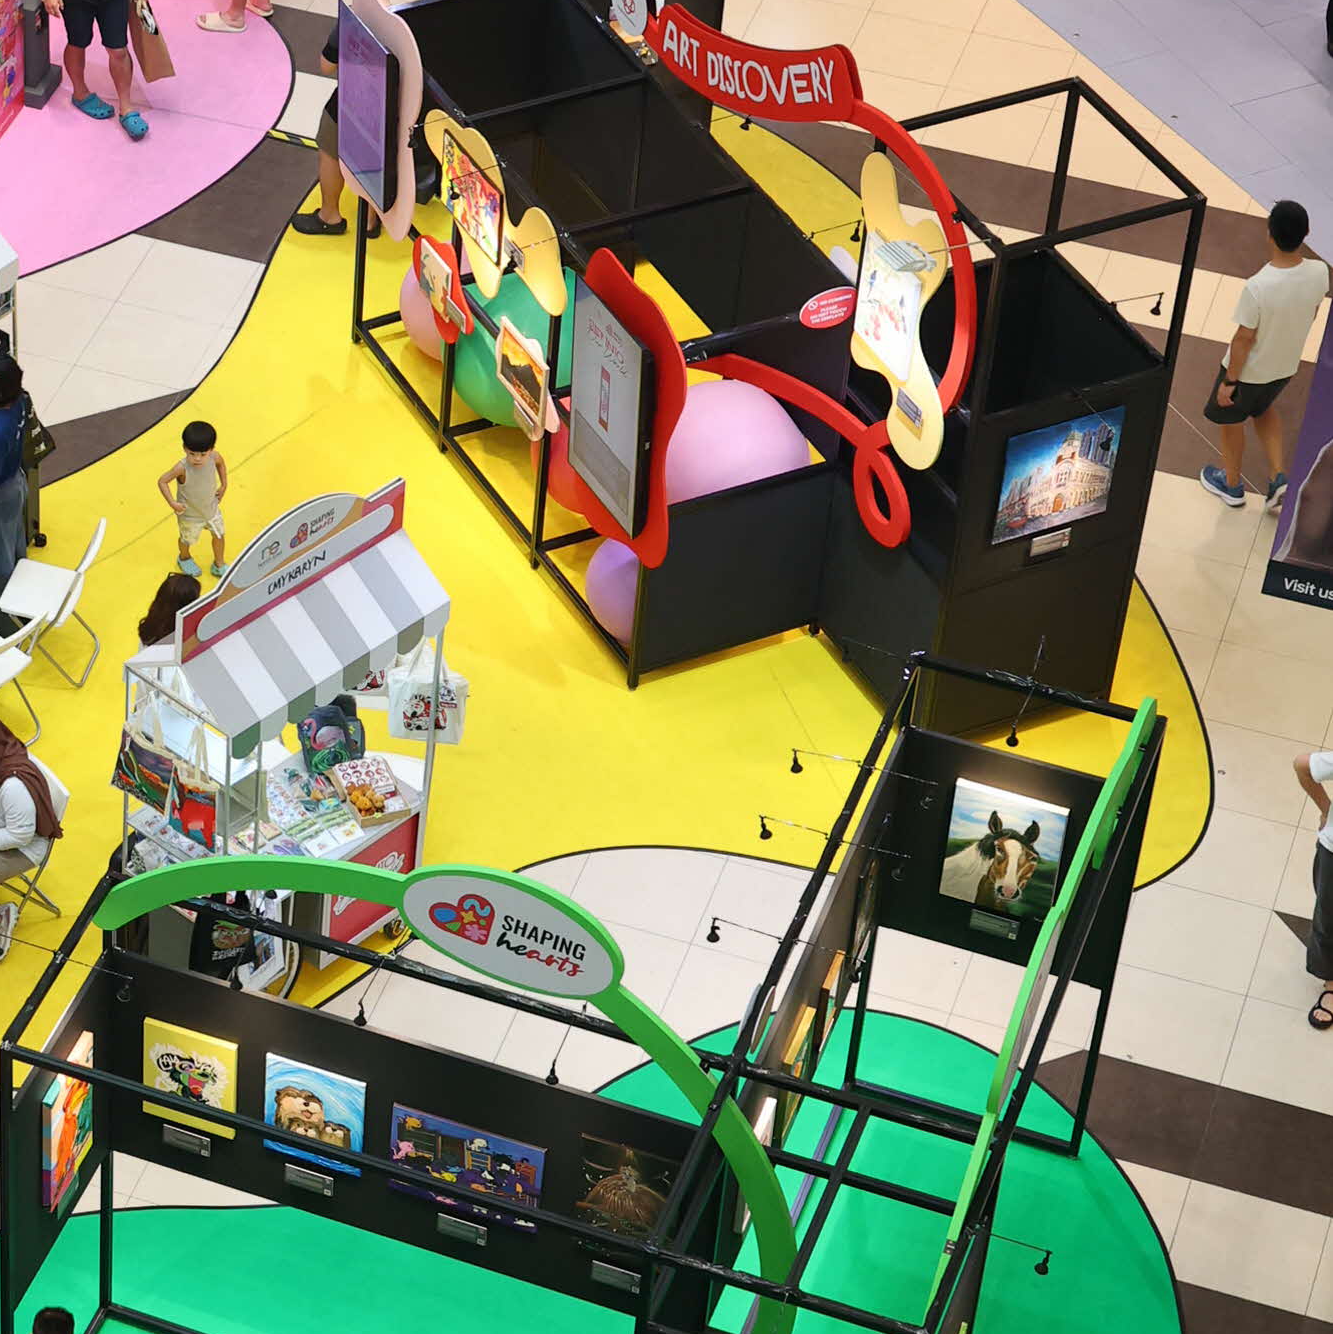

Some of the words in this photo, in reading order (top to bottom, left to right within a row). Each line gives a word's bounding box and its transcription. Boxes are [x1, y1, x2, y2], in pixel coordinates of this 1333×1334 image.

[662, 20, 700, 78] ART
[706, 50, 835, 105] DISCOVERY
[267, 549, 327, 596] CMYKARYN
[1283, 577, 1317, 596] Visit
[1318, 588, 1333, 601] us
[496, 931, 586, 978] hearts
[502, 914, 586, 962] SHAPING
